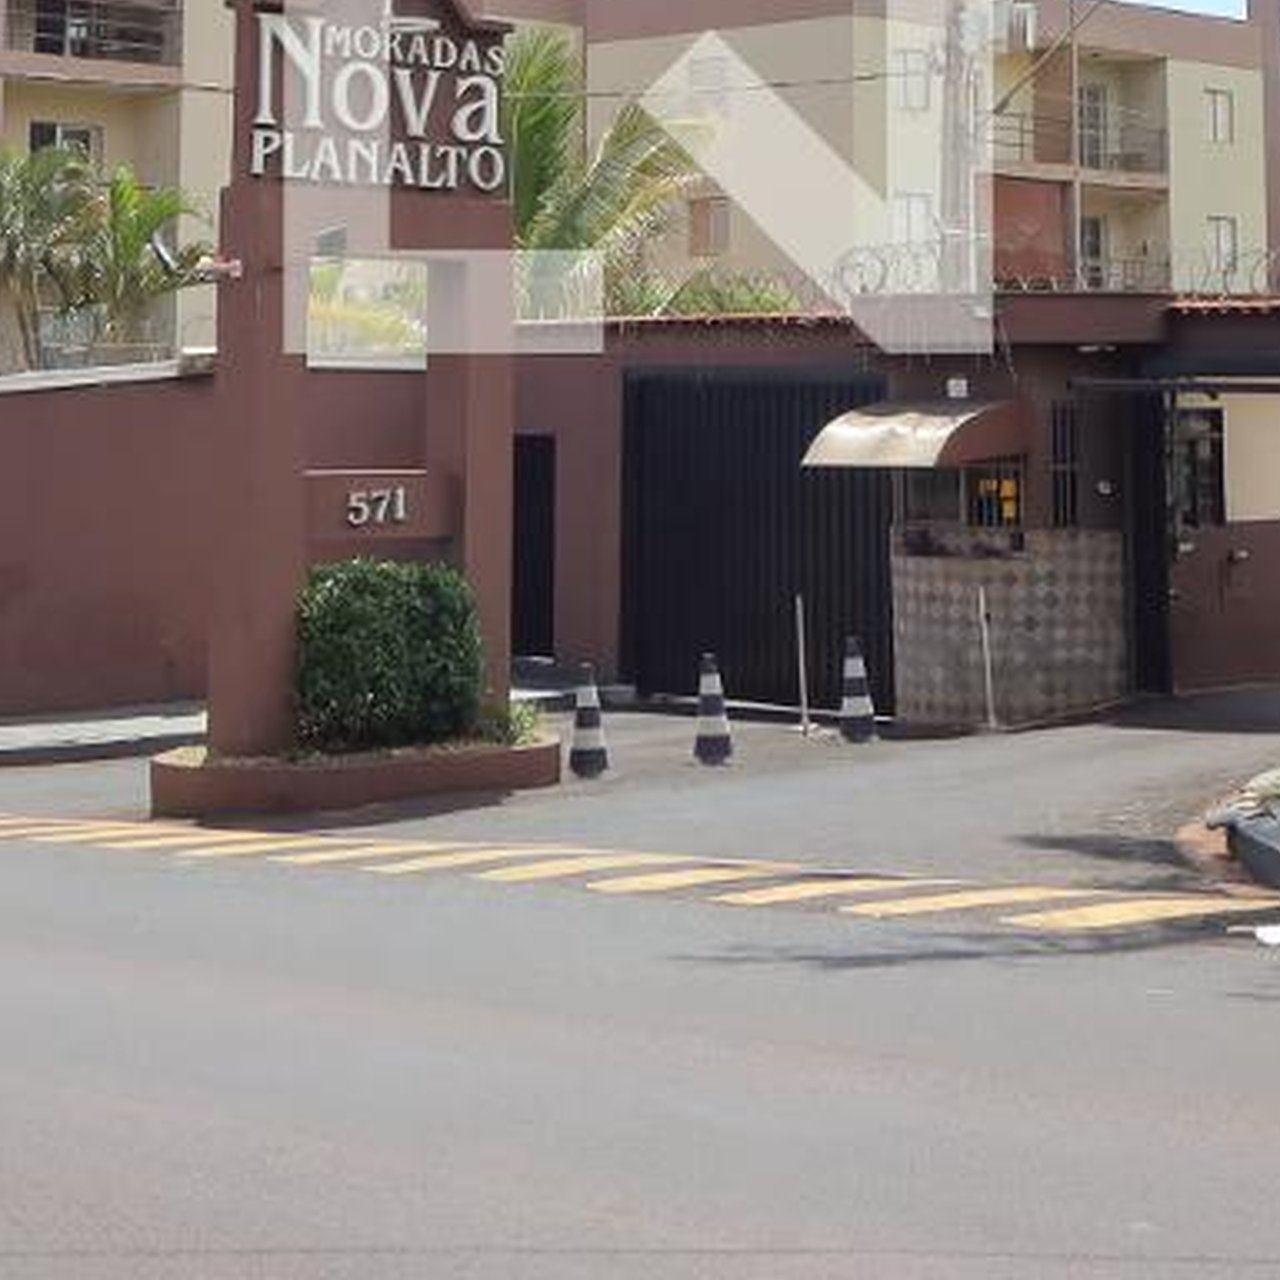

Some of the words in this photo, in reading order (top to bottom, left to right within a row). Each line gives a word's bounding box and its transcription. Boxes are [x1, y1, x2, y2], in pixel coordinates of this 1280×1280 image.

[324, 24, 505, 75] MORADAS
[251, 131, 505, 190] PLANALTO
[347, 486, 406, 525] 571
